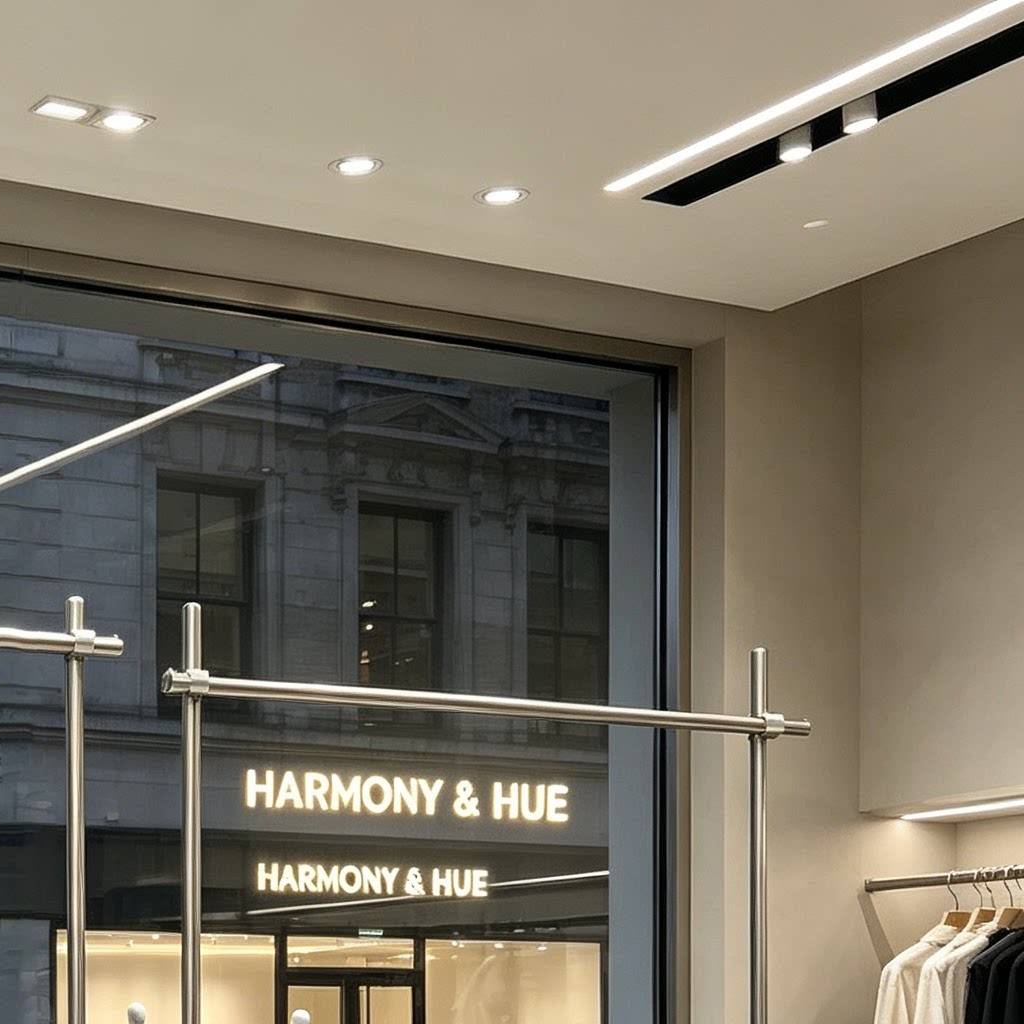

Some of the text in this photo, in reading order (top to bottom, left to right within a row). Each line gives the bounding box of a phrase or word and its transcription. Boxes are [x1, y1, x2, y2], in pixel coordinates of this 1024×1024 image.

[246, 769, 569, 822] HARMONY & HUE
[257, 863, 489, 897] HARMONY & HUE
